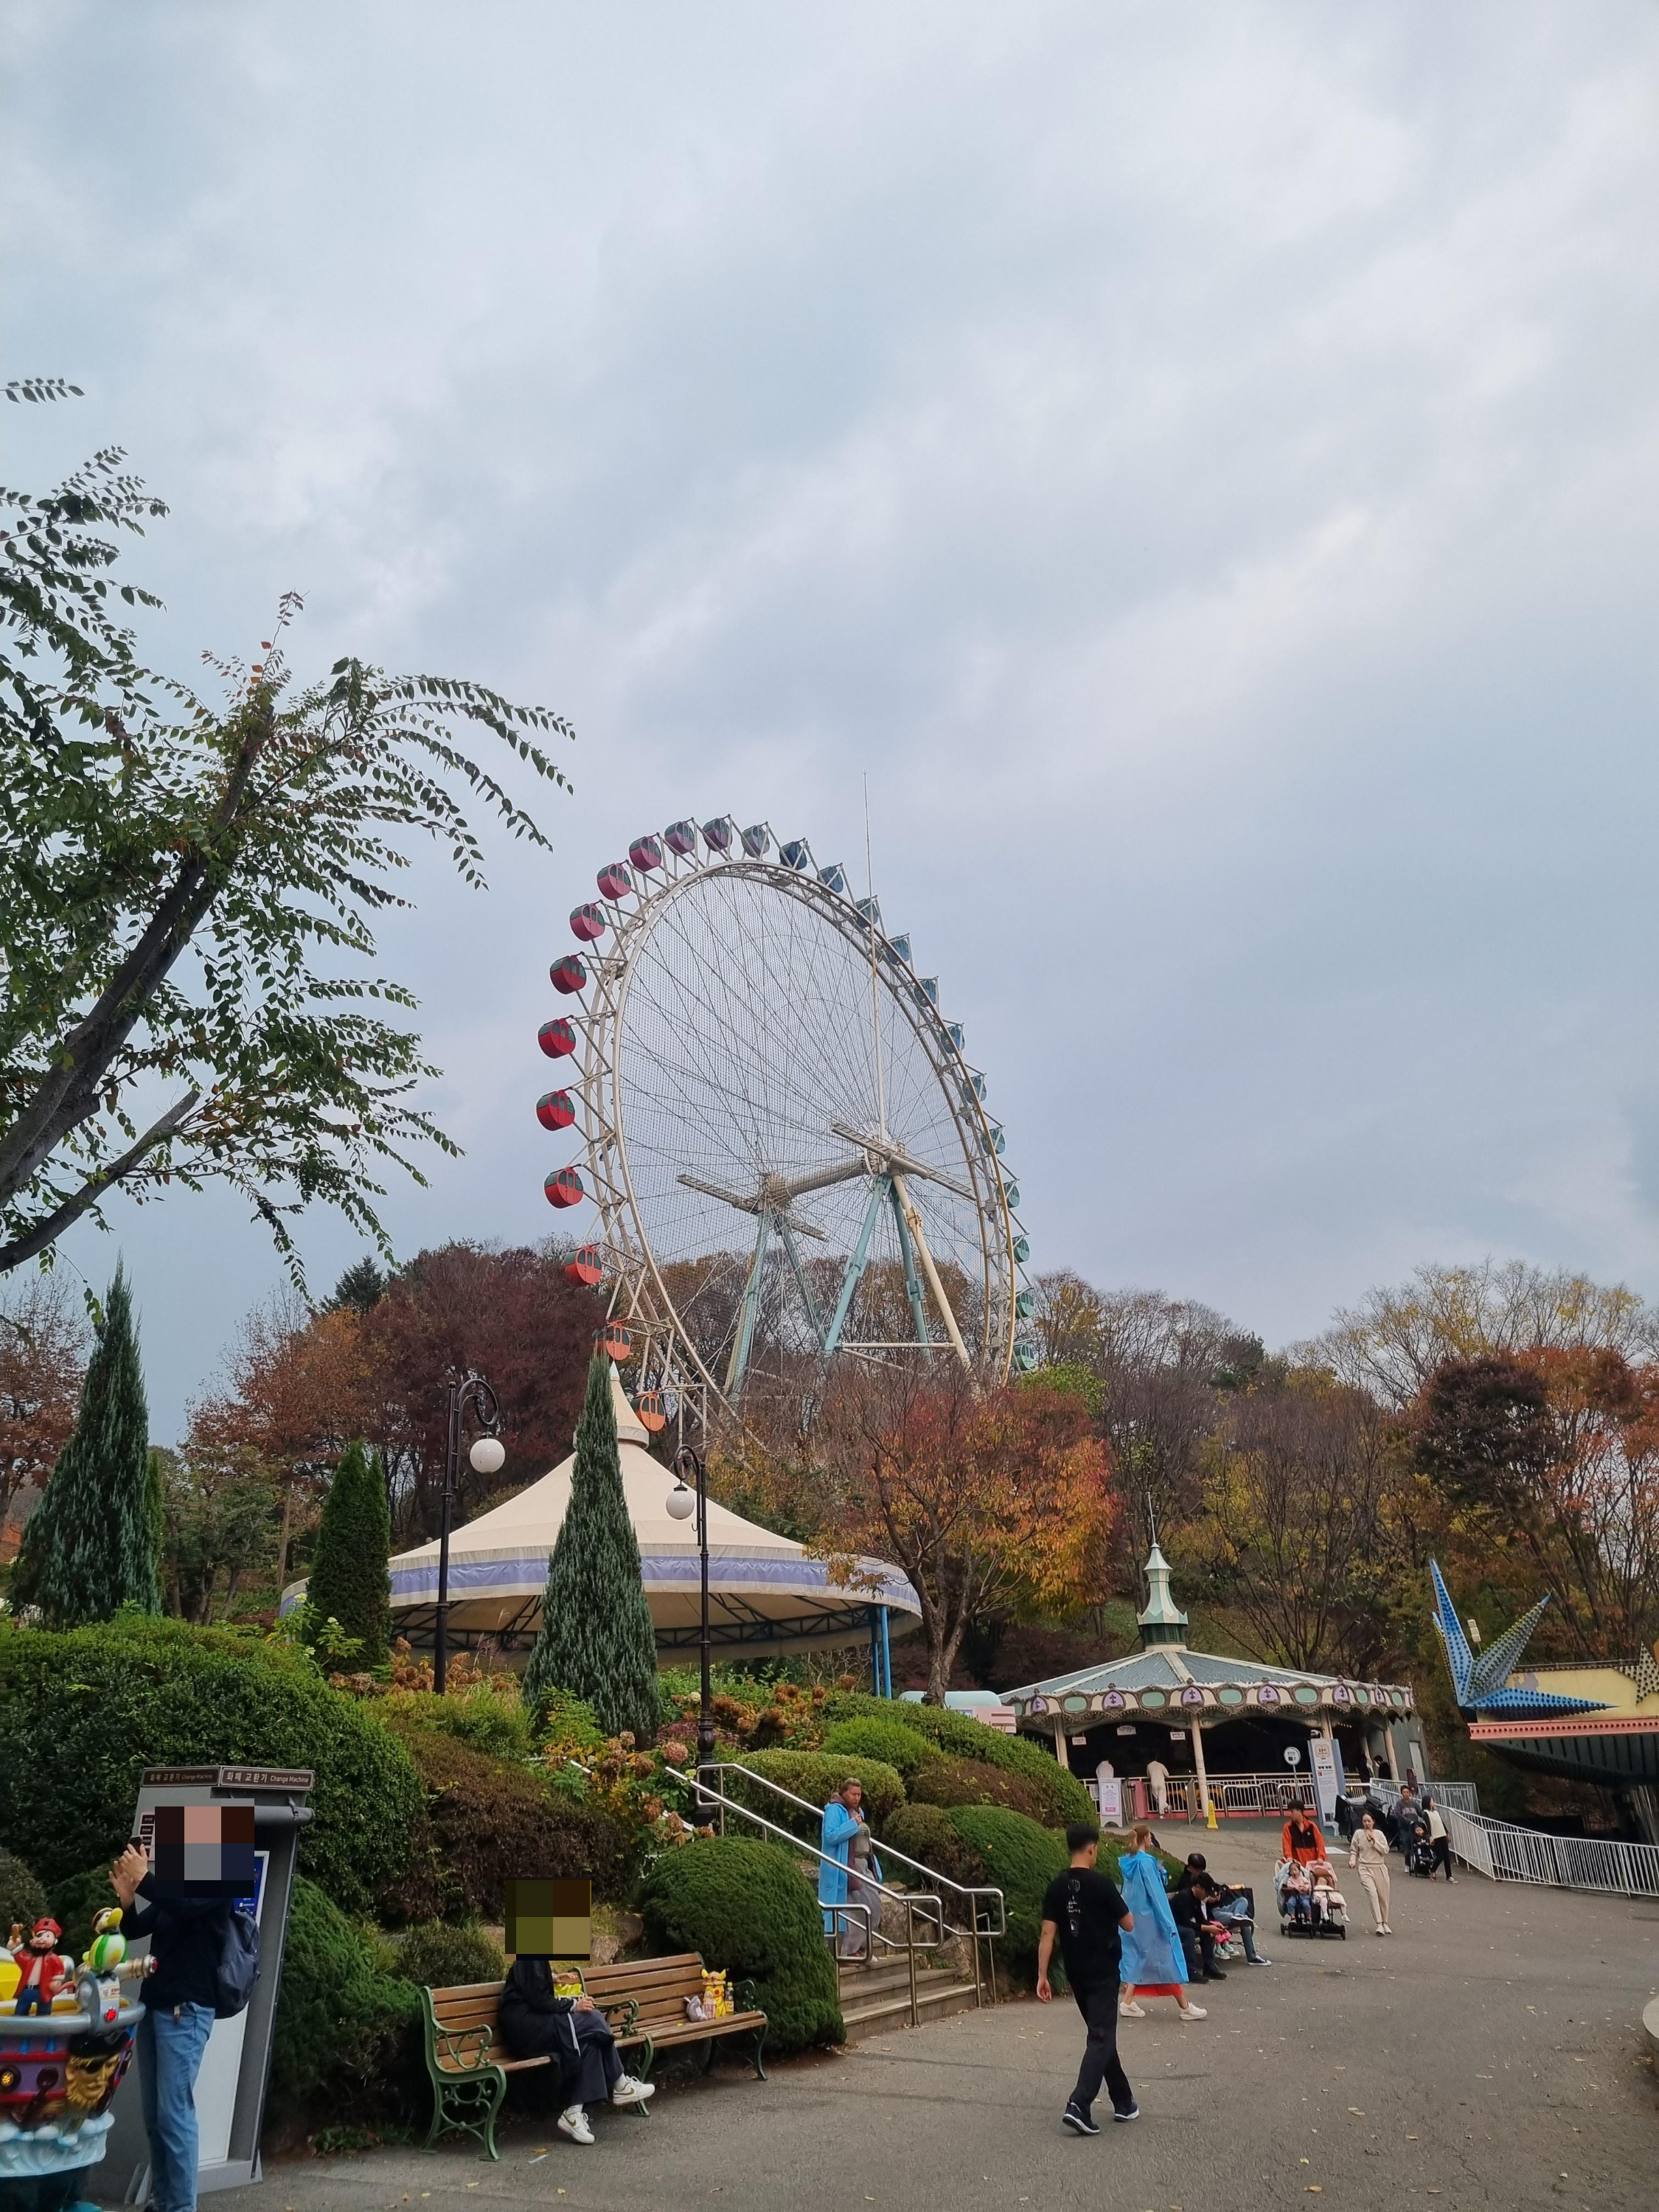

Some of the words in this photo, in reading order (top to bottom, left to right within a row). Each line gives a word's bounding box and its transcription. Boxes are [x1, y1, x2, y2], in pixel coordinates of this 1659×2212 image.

[226, 1771, 242, 1781] 화폐
[245, 1773, 268, 1783] 교환기
[270, 1775, 288, 1784] Change
